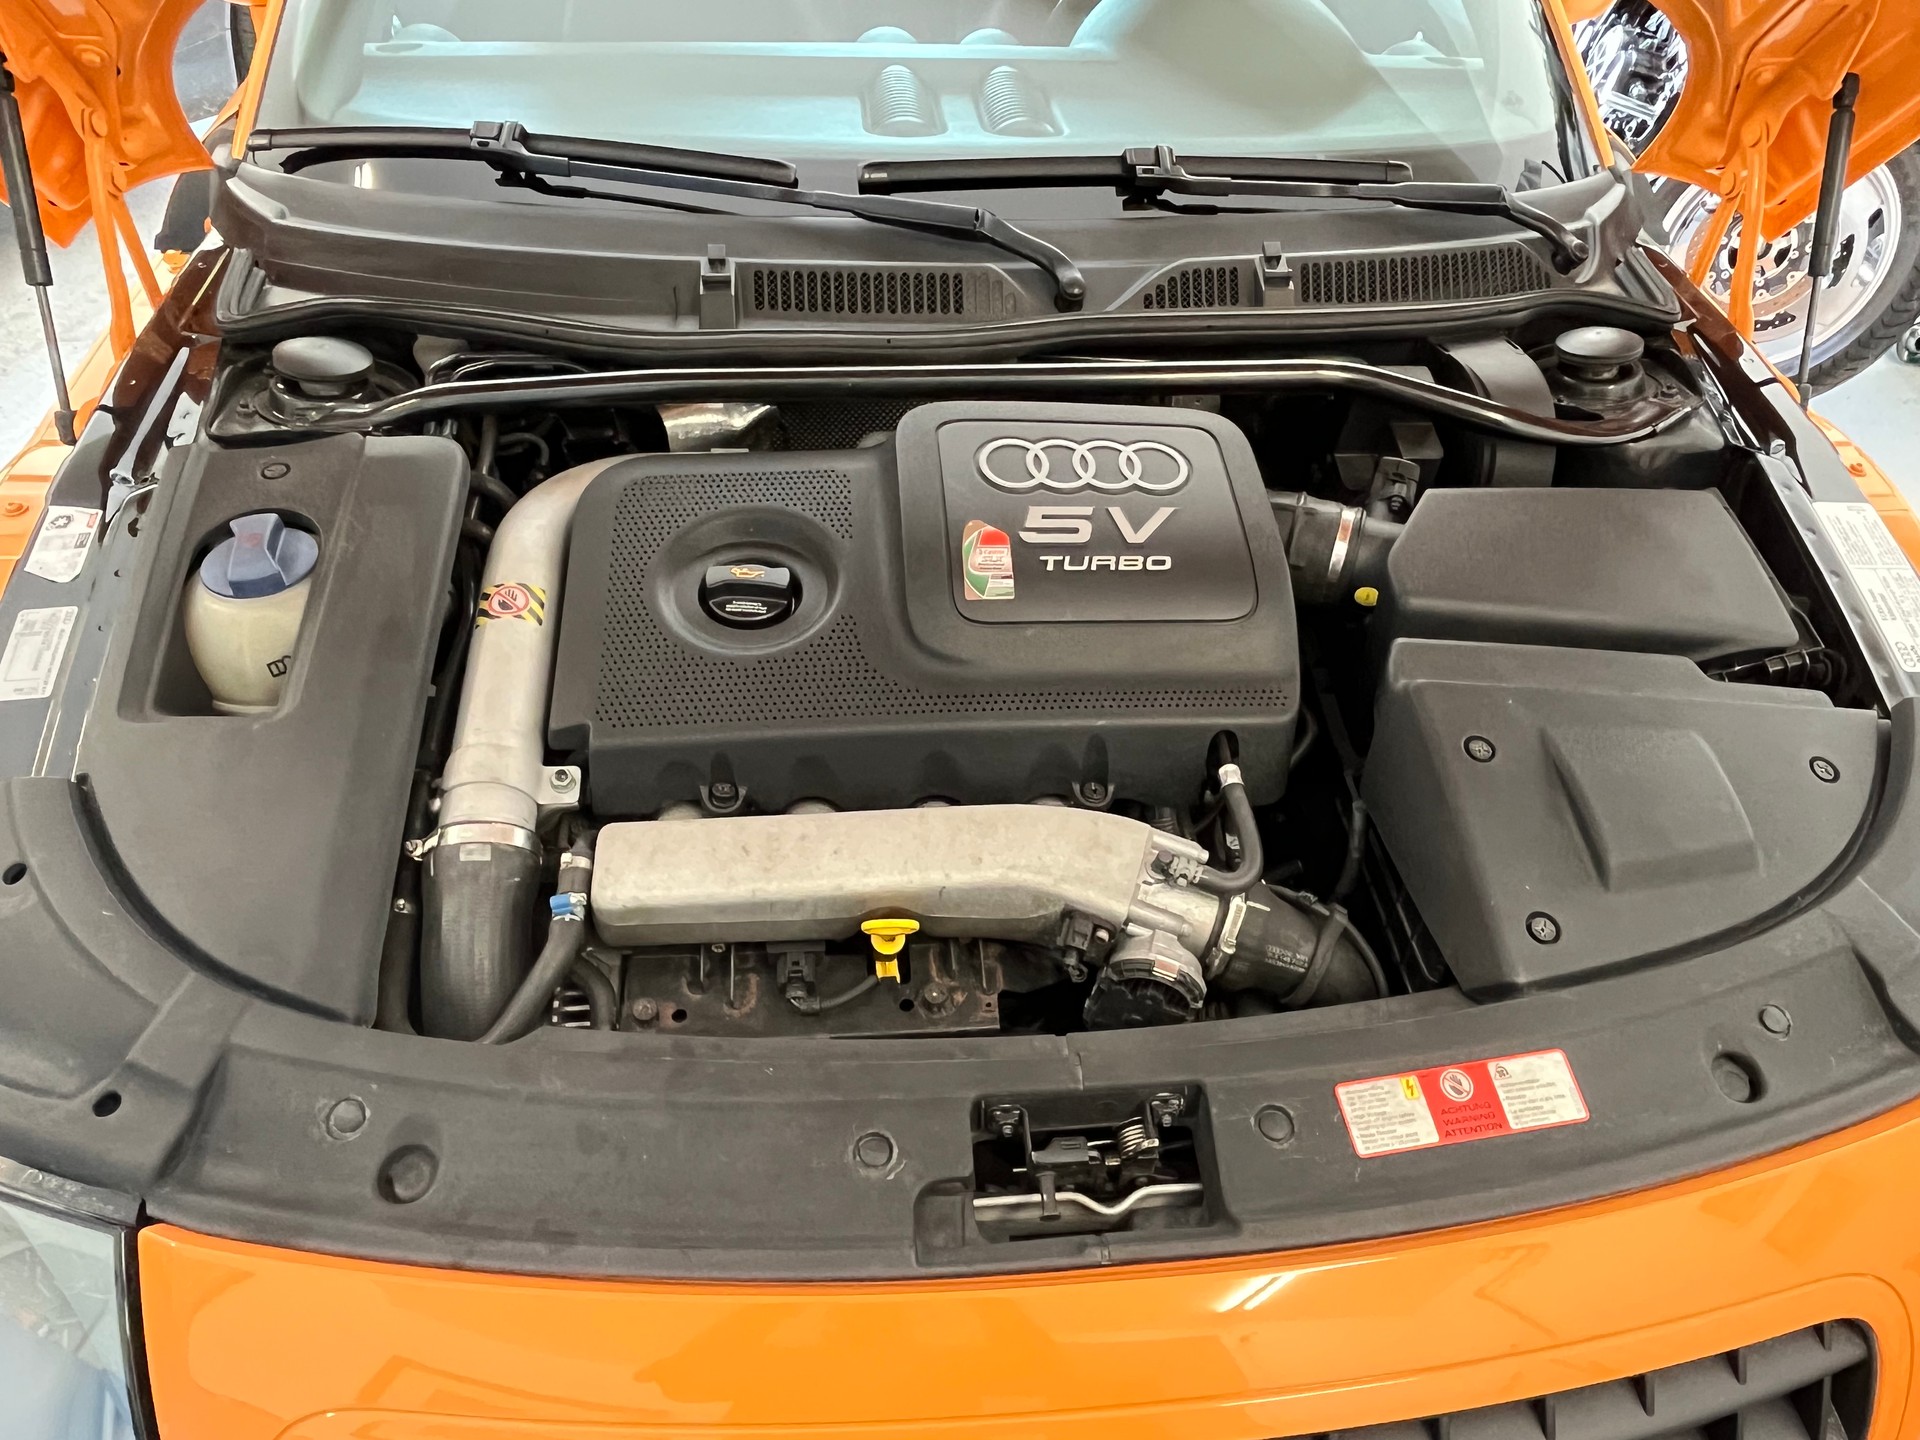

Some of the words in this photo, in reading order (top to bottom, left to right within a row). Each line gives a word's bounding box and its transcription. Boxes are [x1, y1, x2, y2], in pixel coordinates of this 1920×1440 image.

[1039, 555, 1172, 572] TURBO
[1441, 1101, 1492, 1115] ACHTUNG
[1443, 1111, 1496, 1126] WARNING
[1445, 1122, 1503, 1138] ATTENTION
